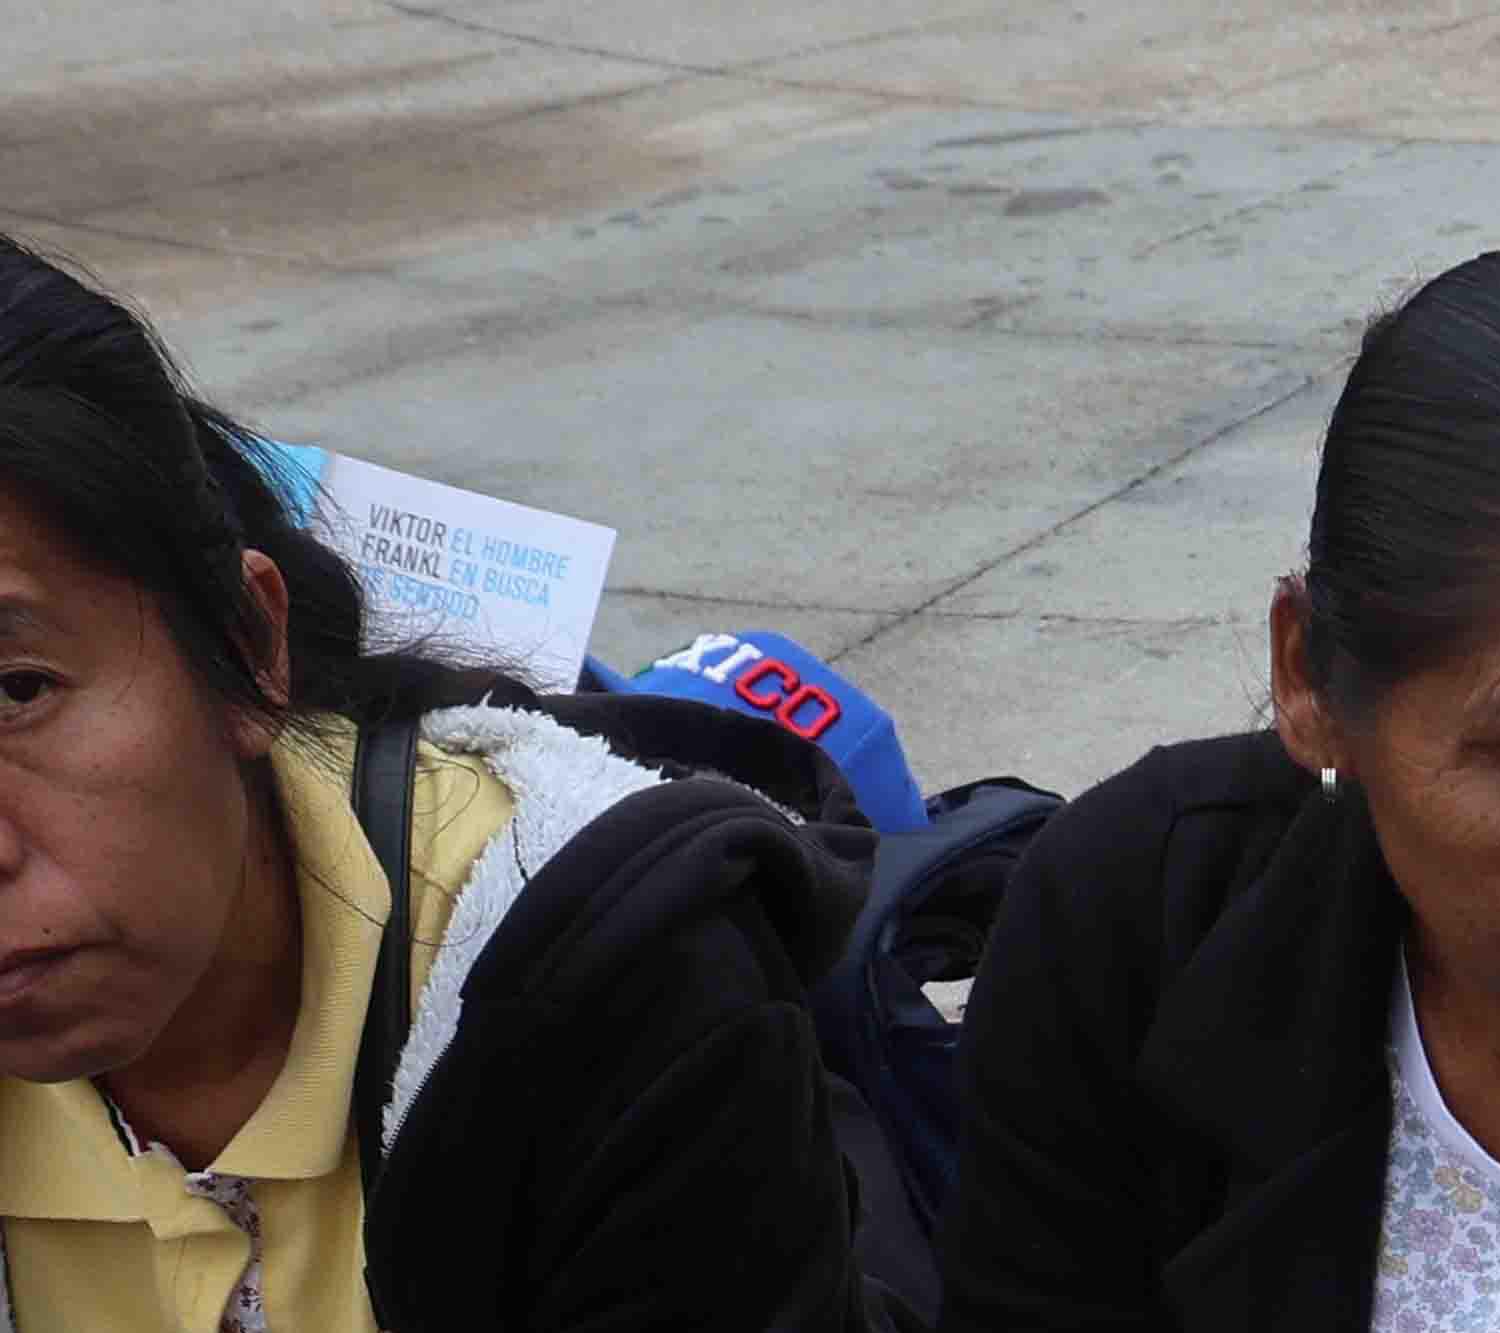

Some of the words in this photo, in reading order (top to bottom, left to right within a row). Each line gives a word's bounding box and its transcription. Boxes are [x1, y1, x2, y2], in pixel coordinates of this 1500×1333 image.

[360, 533, 442, 579] FRANKL
[449, 559, 480, 587] EN
[483, 569, 550, 607] BUSCA
[369, 503, 447, 547] VIKTOR
[450, 527, 474, 556] EL
[481, 536, 570, 578] HOMBRE
[634, 633, 842, 741] XICO
